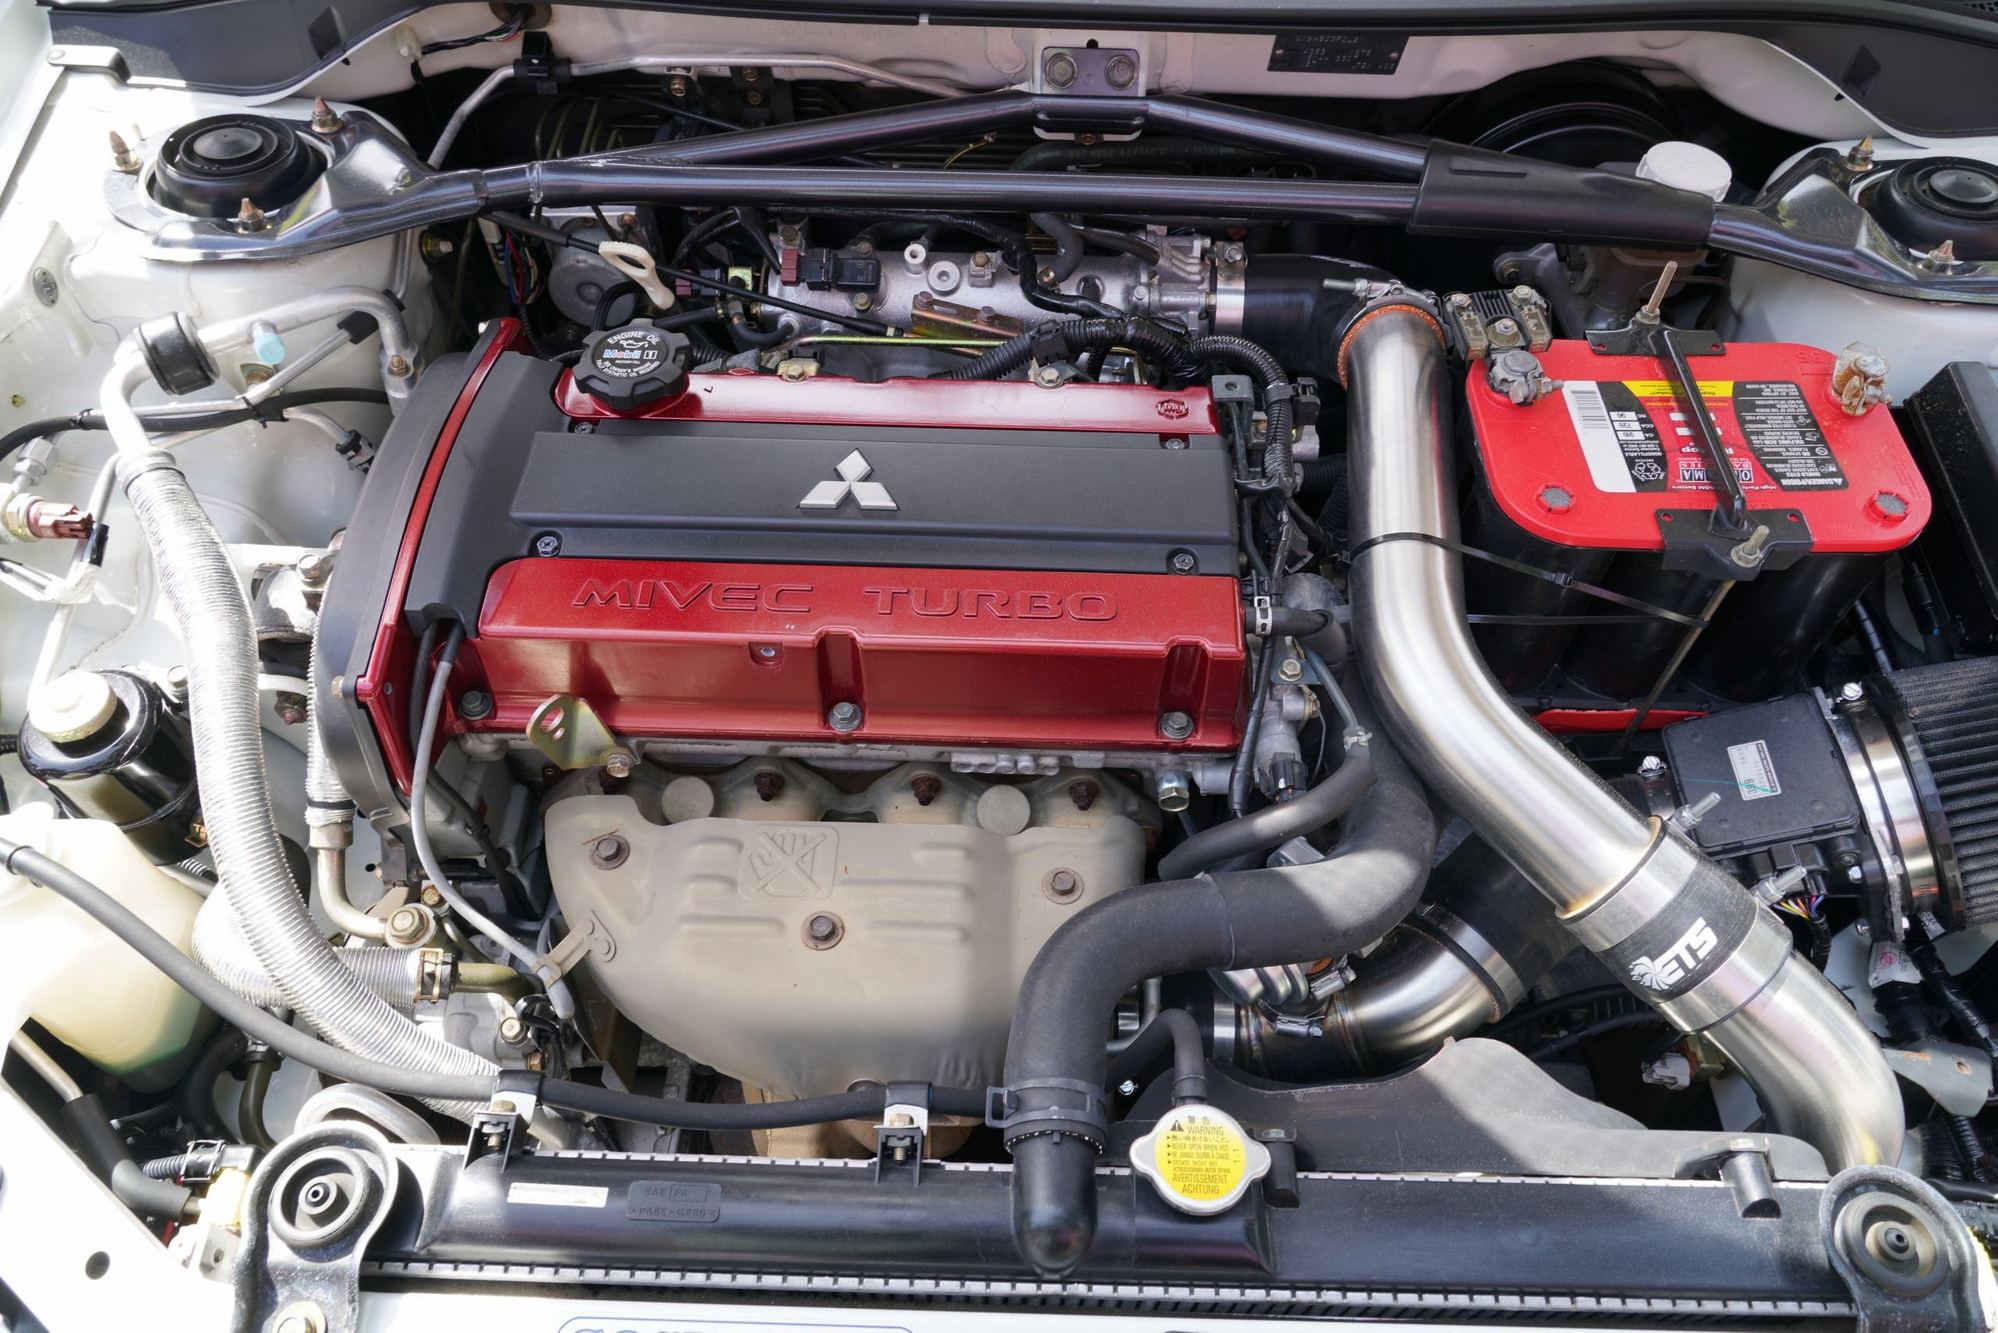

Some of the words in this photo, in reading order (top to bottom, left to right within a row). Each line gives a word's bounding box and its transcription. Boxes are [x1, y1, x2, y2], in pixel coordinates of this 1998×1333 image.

[607, 331, 645, 344] ENGINE
[646, 334, 660, 345] OIL
[603, 349, 642, 359] Mobil
[572, 578, 813, 612] MIVEC
[864, 586, 1118, 621] TURBO
[1652, 917, 1718, 988] ETS
[1187, 1125, 1224, 1136] WARNING
[1172, 1173, 1228, 1184] AVERTISSEMENT
[645, 1187, 667, 1196] SAE
[1182, 1184, 1220, 1195] ACHTUNG
